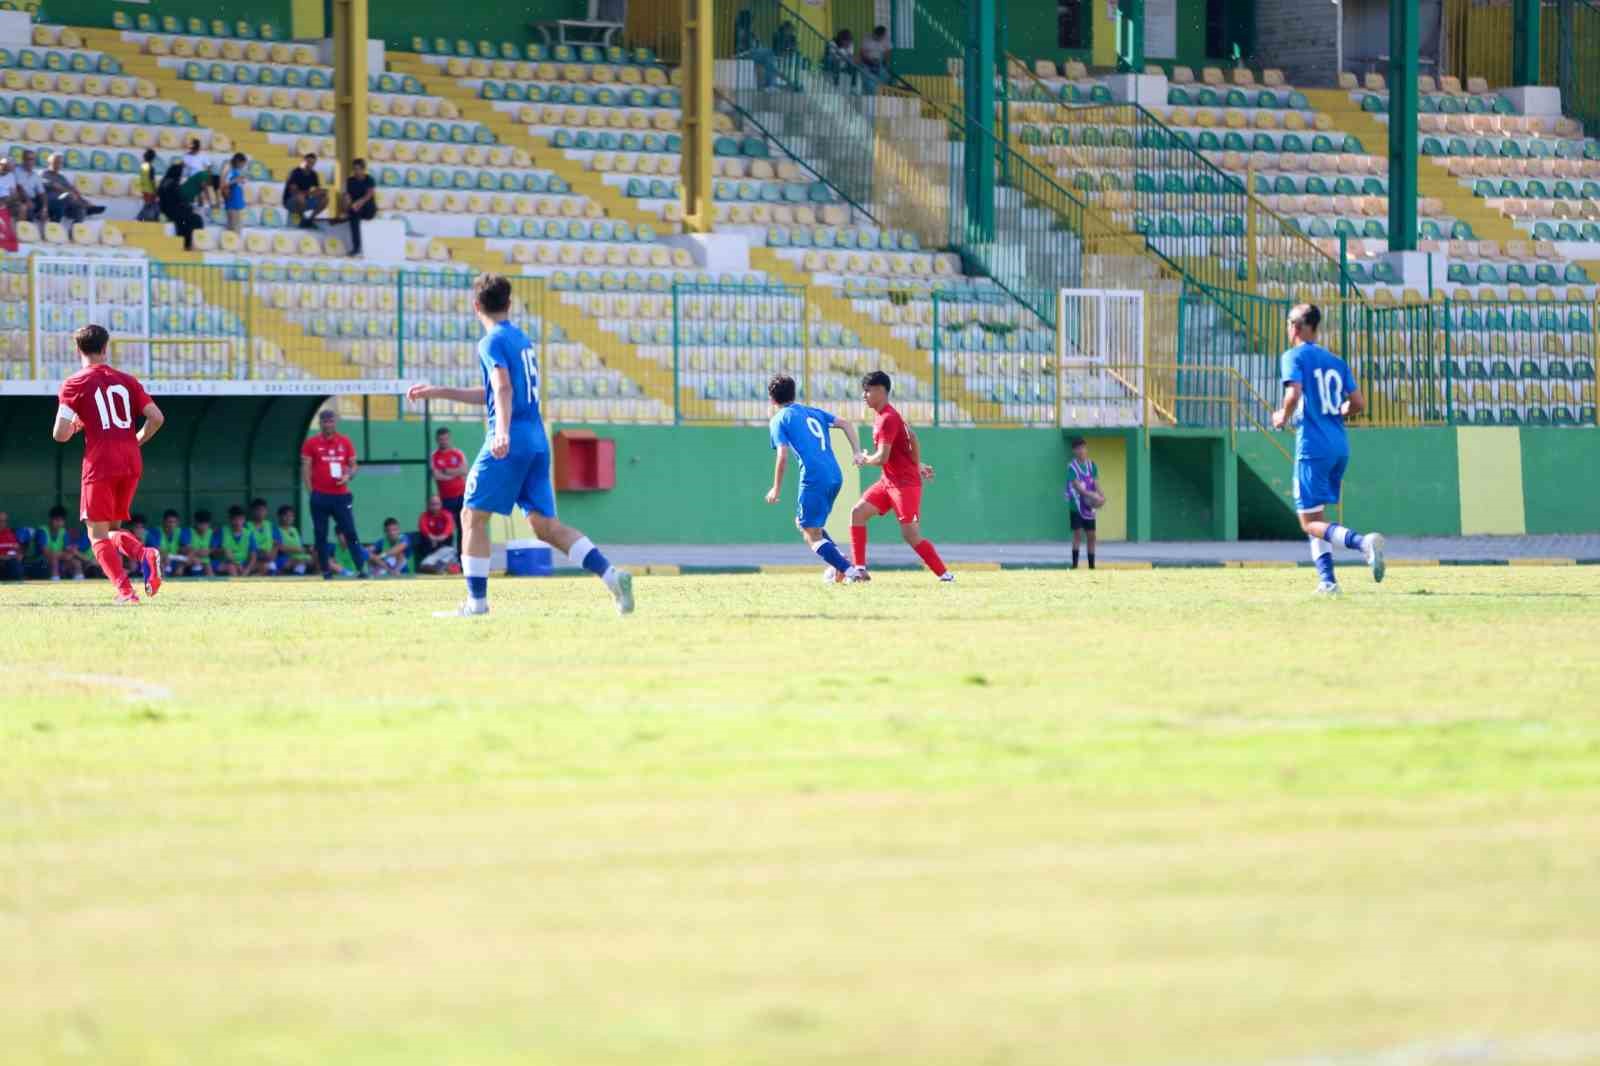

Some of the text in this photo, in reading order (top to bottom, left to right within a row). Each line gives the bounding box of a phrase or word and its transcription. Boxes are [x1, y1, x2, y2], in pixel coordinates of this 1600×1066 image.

[520, 348, 540, 404] 15
[1313, 368, 1343, 416] 10
[94, 384, 132, 430] 10
[806, 416, 827, 452] 9
